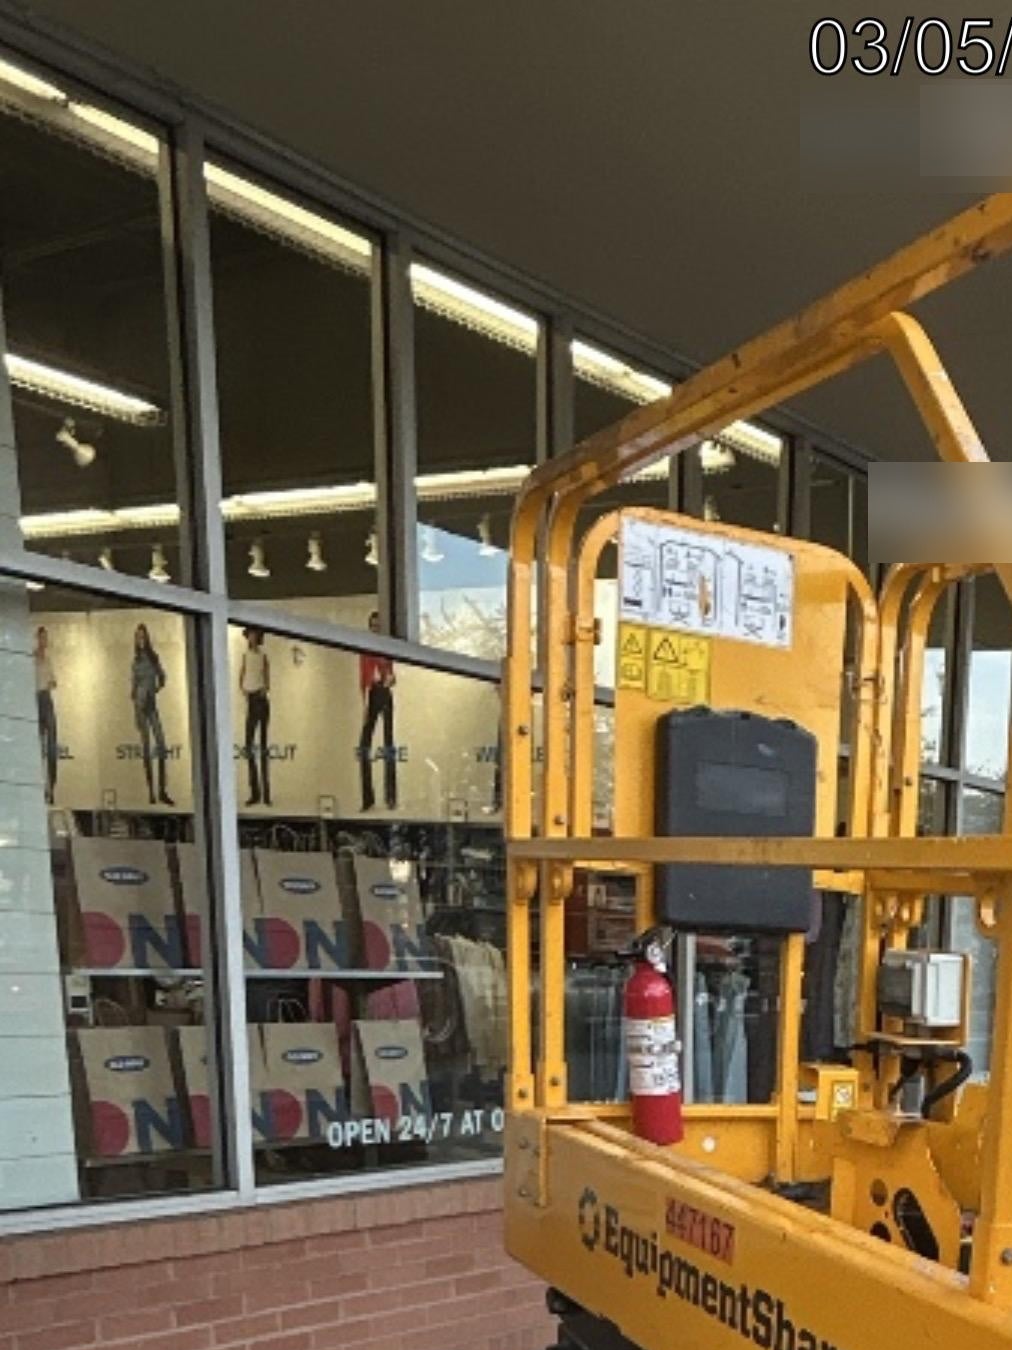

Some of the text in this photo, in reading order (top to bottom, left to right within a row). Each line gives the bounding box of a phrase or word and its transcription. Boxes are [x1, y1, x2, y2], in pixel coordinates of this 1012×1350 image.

[115, 743, 183, 760] STRGHT
[326, 1118, 391, 1148] OPEN
[399, 1112, 454, 1144] 24/7
[460, 1109, 485, 1135] AT
[665, 1200, 736, 1258] 447167
